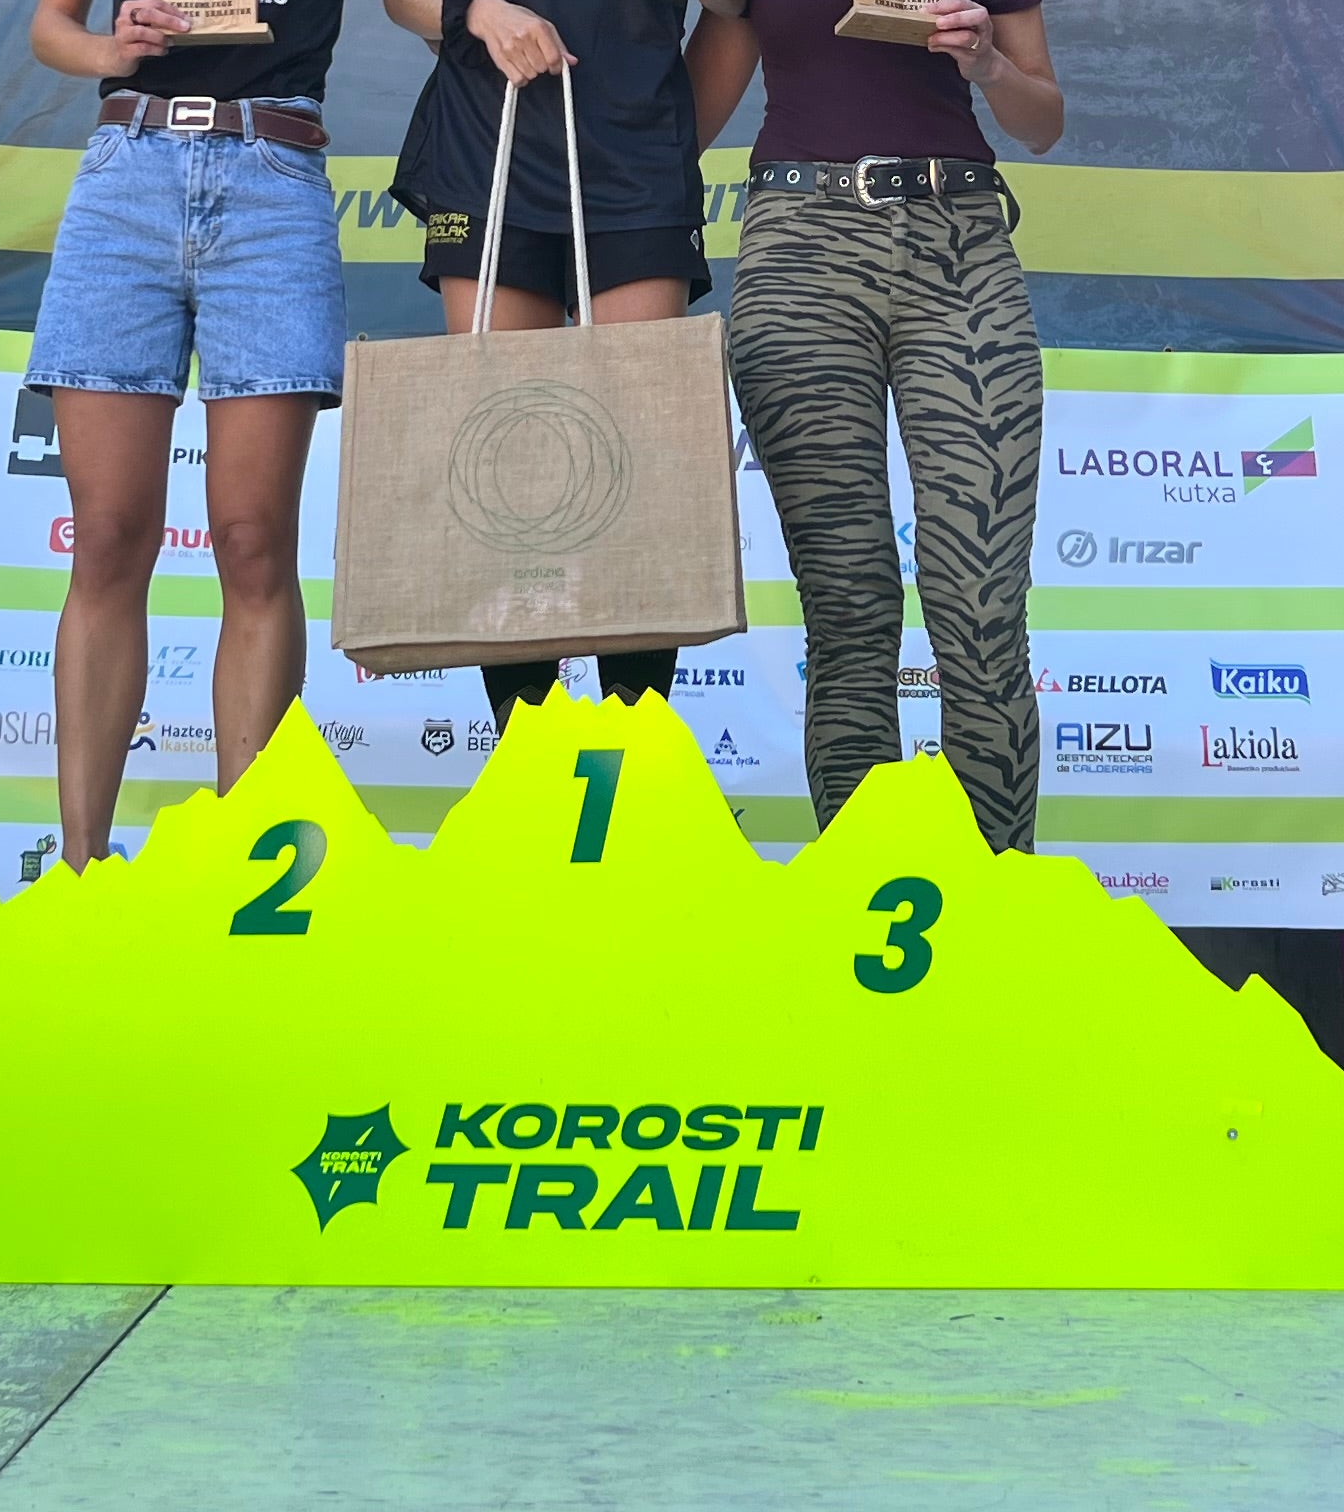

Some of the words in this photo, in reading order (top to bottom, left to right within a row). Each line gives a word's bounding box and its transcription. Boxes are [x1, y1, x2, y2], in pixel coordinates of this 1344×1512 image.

[1057, 447, 1234, 477] LABORAL
[1162, 483, 1236, 503] kutxa
[1108, 536, 1203, 564] Irizar
[1067, 674, 1168, 695] BELLOTA
[1220, 668, 1301, 698] Kaiku
[1056, 722, 1152, 751] AIZU
[1199, 724, 1299, 767] Lakiola
[569, 748, 626, 863] 1
[228, 819, 328, 936] 2
[853, 875, 944, 994] 3
[434, 1102, 825, 1151] KOROSTI
[320, 1160, 378, 1174] TRAIL
[321, 1151, 382, 1162] KOROSTI
[424, 1163, 802, 1232] TRAIL
